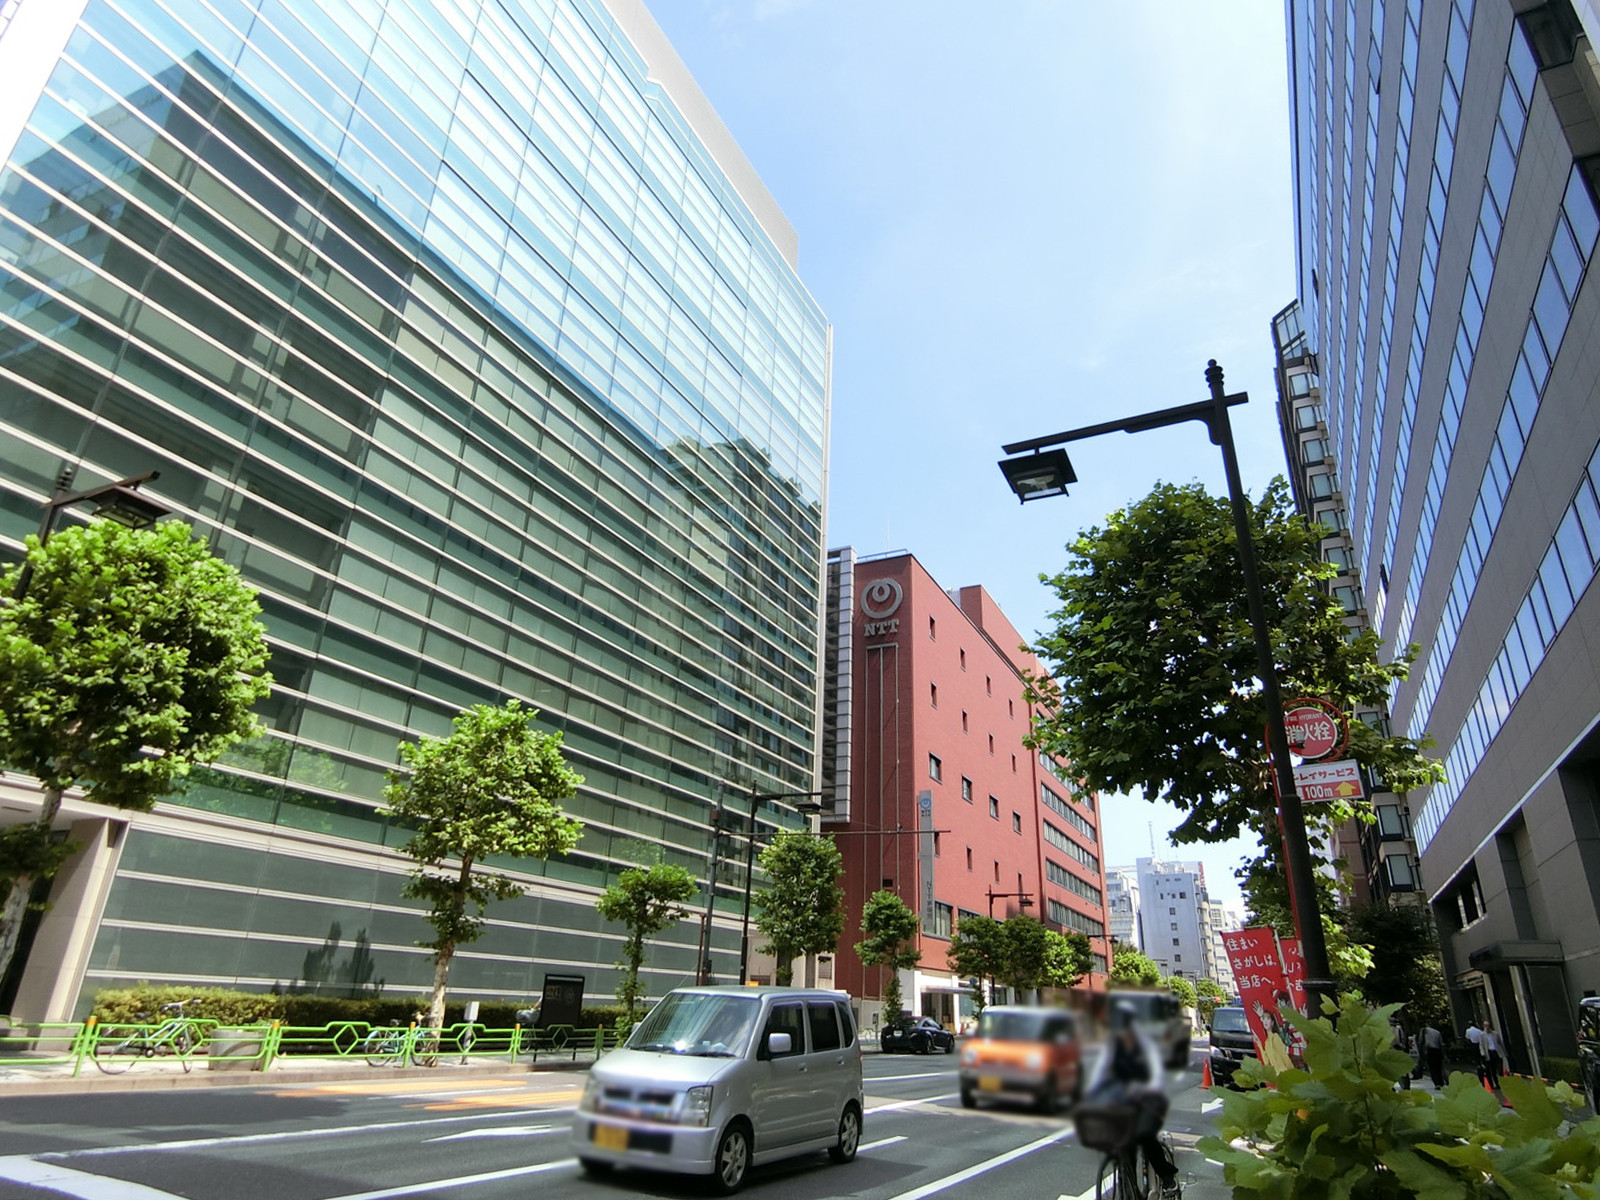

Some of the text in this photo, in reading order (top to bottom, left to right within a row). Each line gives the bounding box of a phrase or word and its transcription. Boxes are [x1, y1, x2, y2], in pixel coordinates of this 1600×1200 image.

[864, 618, 899, 636] NTT
[1285, 721, 1332, 745] 消火栓
[1226, 937, 1259, 952] 住まい
[1233, 954, 1277, 970] さがしは、
[1239, 974, 1275, 989] 当店へ。
